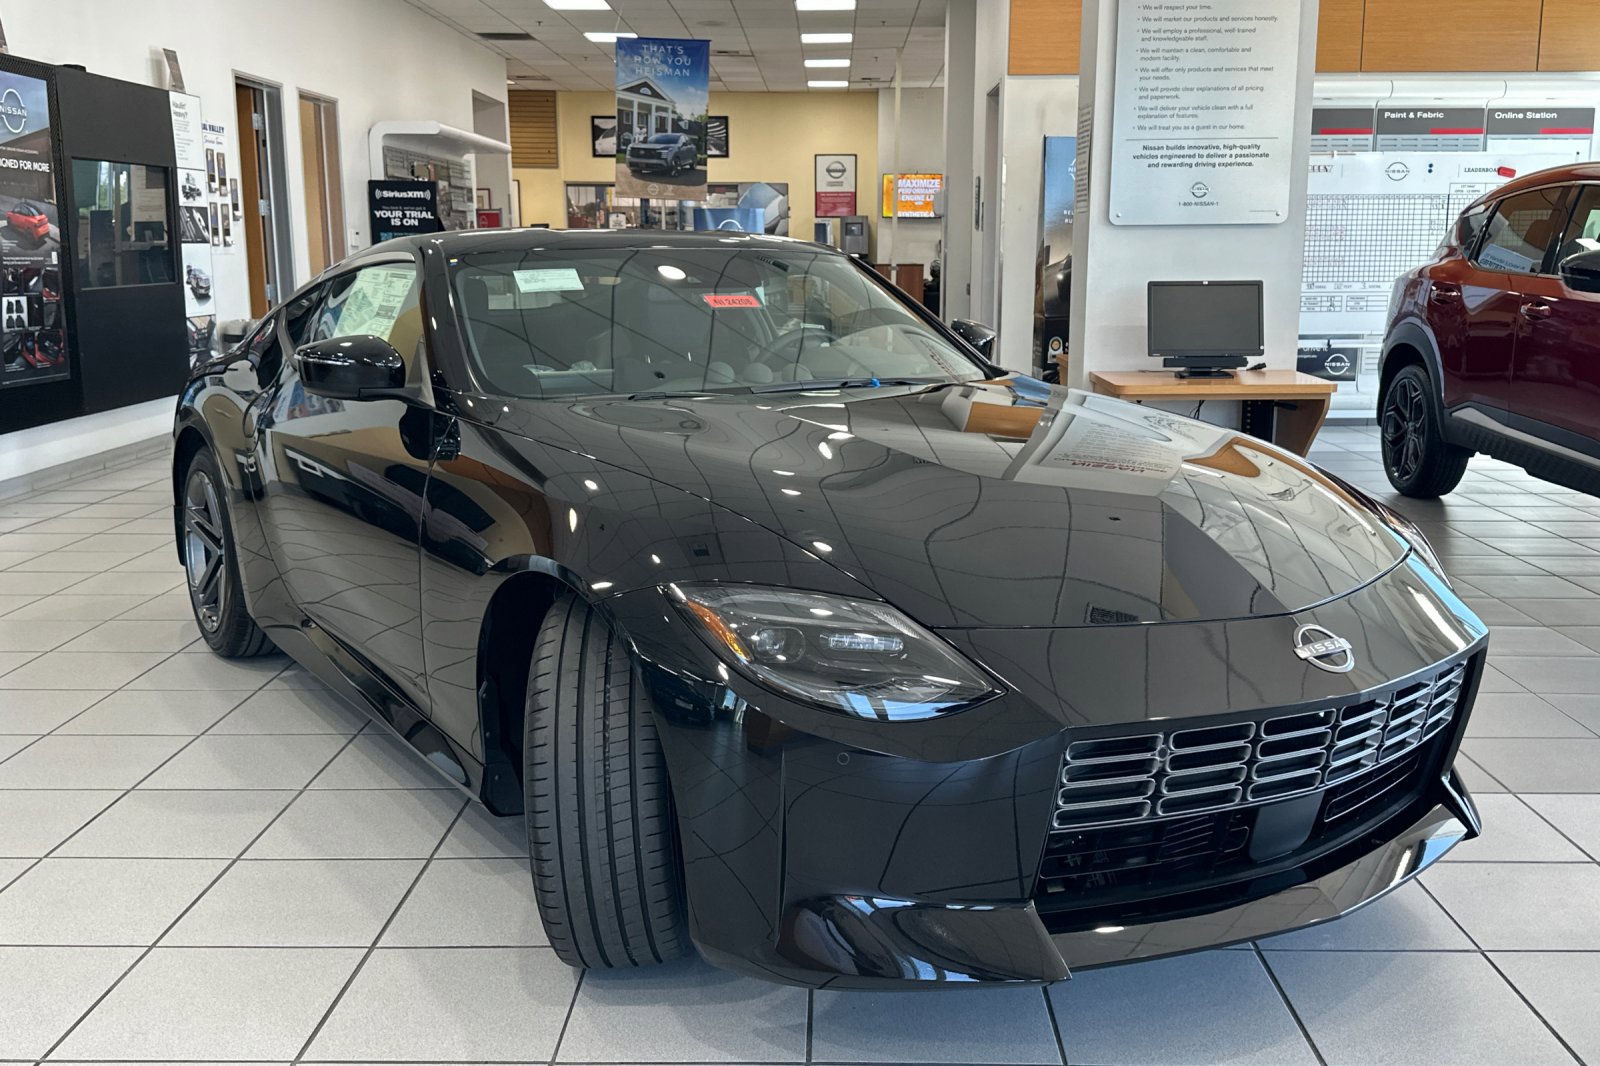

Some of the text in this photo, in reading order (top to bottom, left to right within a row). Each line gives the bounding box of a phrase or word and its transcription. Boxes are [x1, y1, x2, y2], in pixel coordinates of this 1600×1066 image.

[1254, 15, 1279, 23] honestly.
[641, 44, 684, 55] THAT'S
[633, 55, 692, 66] HOW YOU
[635, 66, 691, 77] HEISMAN
[1174, 66, 1187, 74] only
[1245, 85, 1264, 93] pricing
[1384, 111, 1444, 119] Paint & Fabric
[1494, 111, 1558, 119] Online Station
[1222, 143, 1261, 151] high-quality
[1160, 153, 1196, 161] engineered
[1234, 152, 1270, 160] passionate
[19, 160, 33, 171] FOR
[32, 161, 50, 173] MORE
[1160, 161, 1193, 169] rewarding
[1194, 161, 1217, 169] driving
[1217, 161, 1255, 169] experience.
[898, 179, 941, 188] MAXIMIZE
[374, 210, 435, 219] YOUR TRIAL
[390, 218, 419, 226] IS ON
